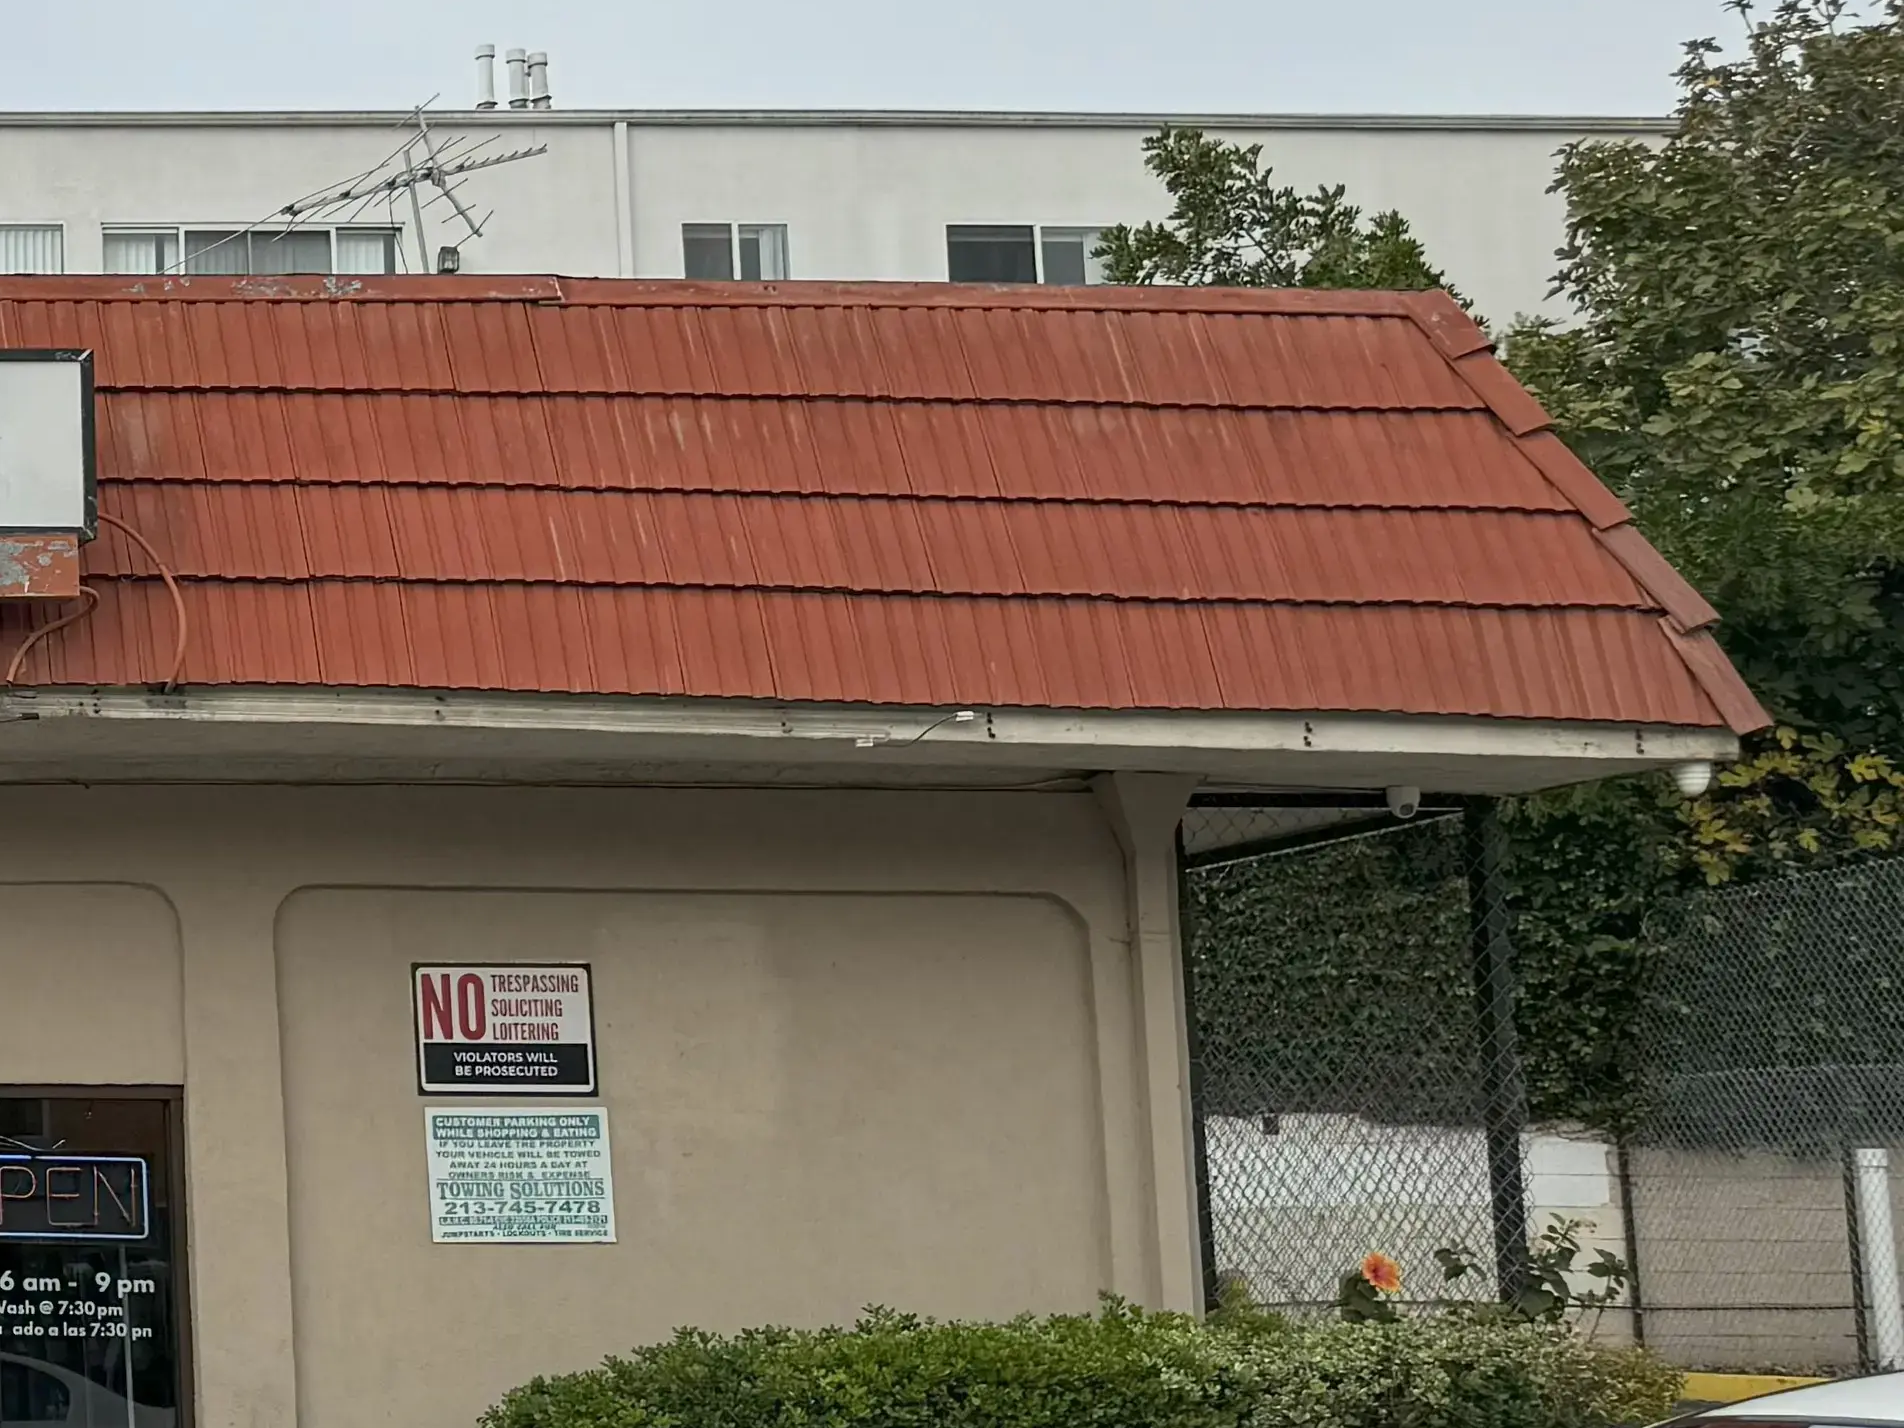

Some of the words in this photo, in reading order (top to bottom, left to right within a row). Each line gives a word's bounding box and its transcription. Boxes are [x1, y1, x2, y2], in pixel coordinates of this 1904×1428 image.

[491, 974, 579, 993] TRESPASSING
[420, 972, 487, 1041] NO
[491, 998, 563, 1017] SOLICITING
[492, 1022, 560, 1041] LOITERING
[453, 1051, 523, 1063] VIOLATORS
[525, 1051, 558, 1063] WILL
[454, 1065, 472, 1076] BE
[475, 1065, 558, 1077] PROSECUTED
[435, 1117, 500, 1127] CUSTOMER
[503, 1117, 556, 1127] PARKING
[559, 1116, 591, 1126] ONLY
[435, 1128, 473, 1138] WHILE
[476, 1128, 538, 1138] SHOPPING
[553, 1127, 597, 1137] EATING
[477, 1140, 512, 1148] LEAVE
[539, 1140, 594, 1148] PROPERTY
[435, 1151, 464, 1159] YOUR
[468, 1151, 514, 1159] VEHICLE
[563, 1150, 600, 1158] TOWED
[499, 1161, 537, 1169] HOURS
[436, 1181, 505, 1200] TOWING
[509, 1180, 605, 1200] SOLUTIONS
[444, 1200, 601, 1215] 213-745-7478
[0, 1269, 15, 1292] 6
[22, 1277, 61, 1292] am
[94, 1271, 111, 1293] 9
[117, 1277, 156, 1299] pm
[39, 1300, 54, 1315] @
[58, 1300, 95, 1316] 7:30
[97, 1303, 123, 1320] pm
[48, 1325, 59, 1337] a
[63, 1323, 87, 1337] las
[90, 1322, 128, 1338] 7:30
